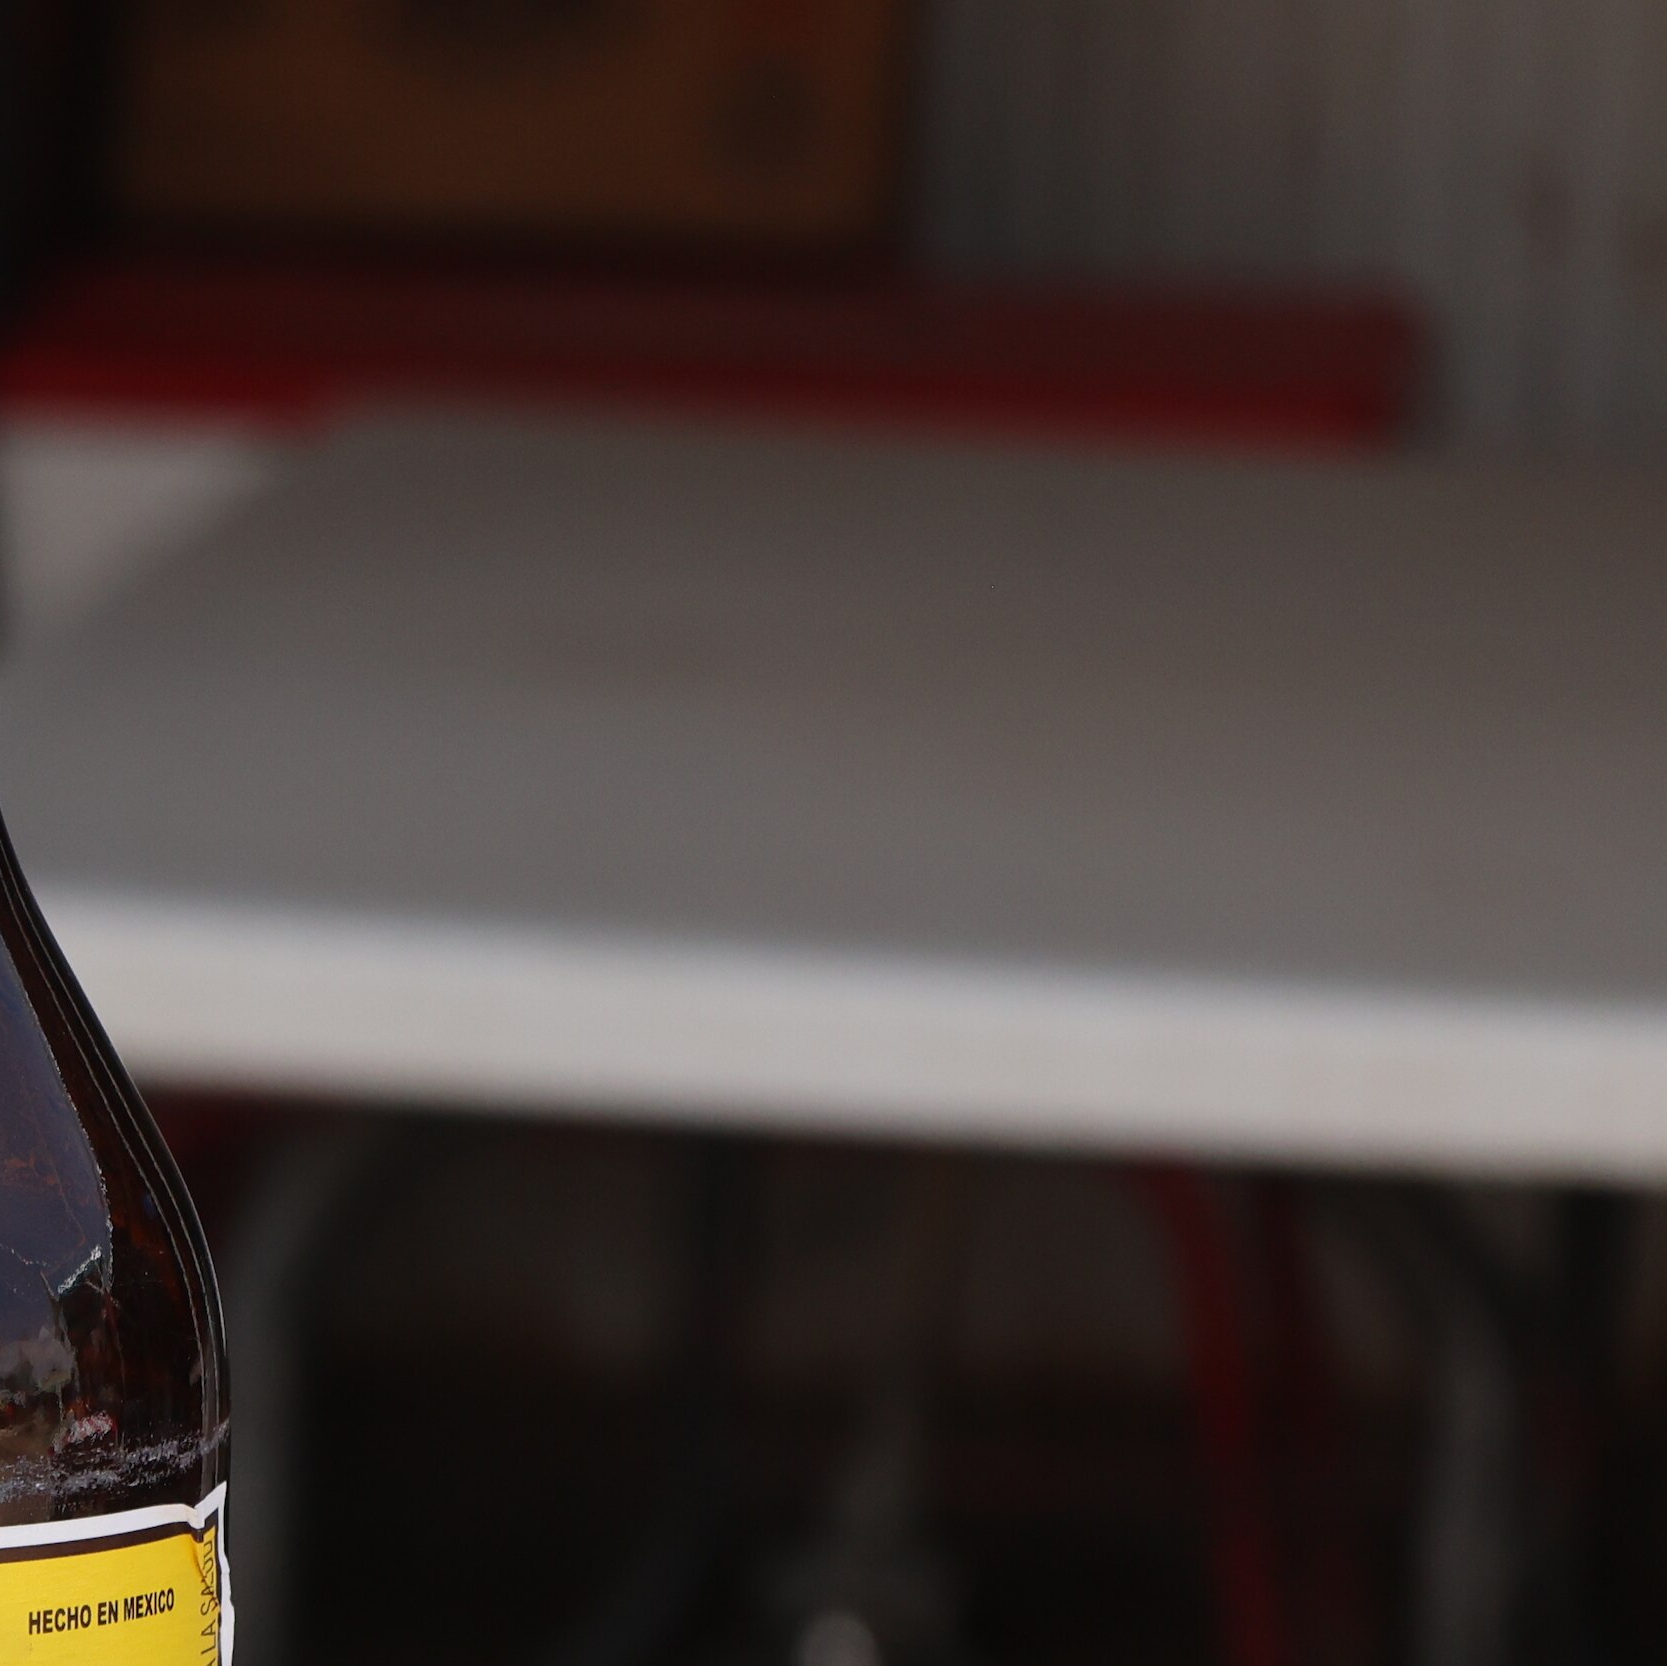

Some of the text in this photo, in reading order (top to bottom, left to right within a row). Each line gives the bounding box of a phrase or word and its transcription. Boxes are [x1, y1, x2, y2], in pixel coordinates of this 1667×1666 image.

[28, 1588, 175, 1636] HECHO EN MEXICO
[201, 1619, 216, 1655] LA
